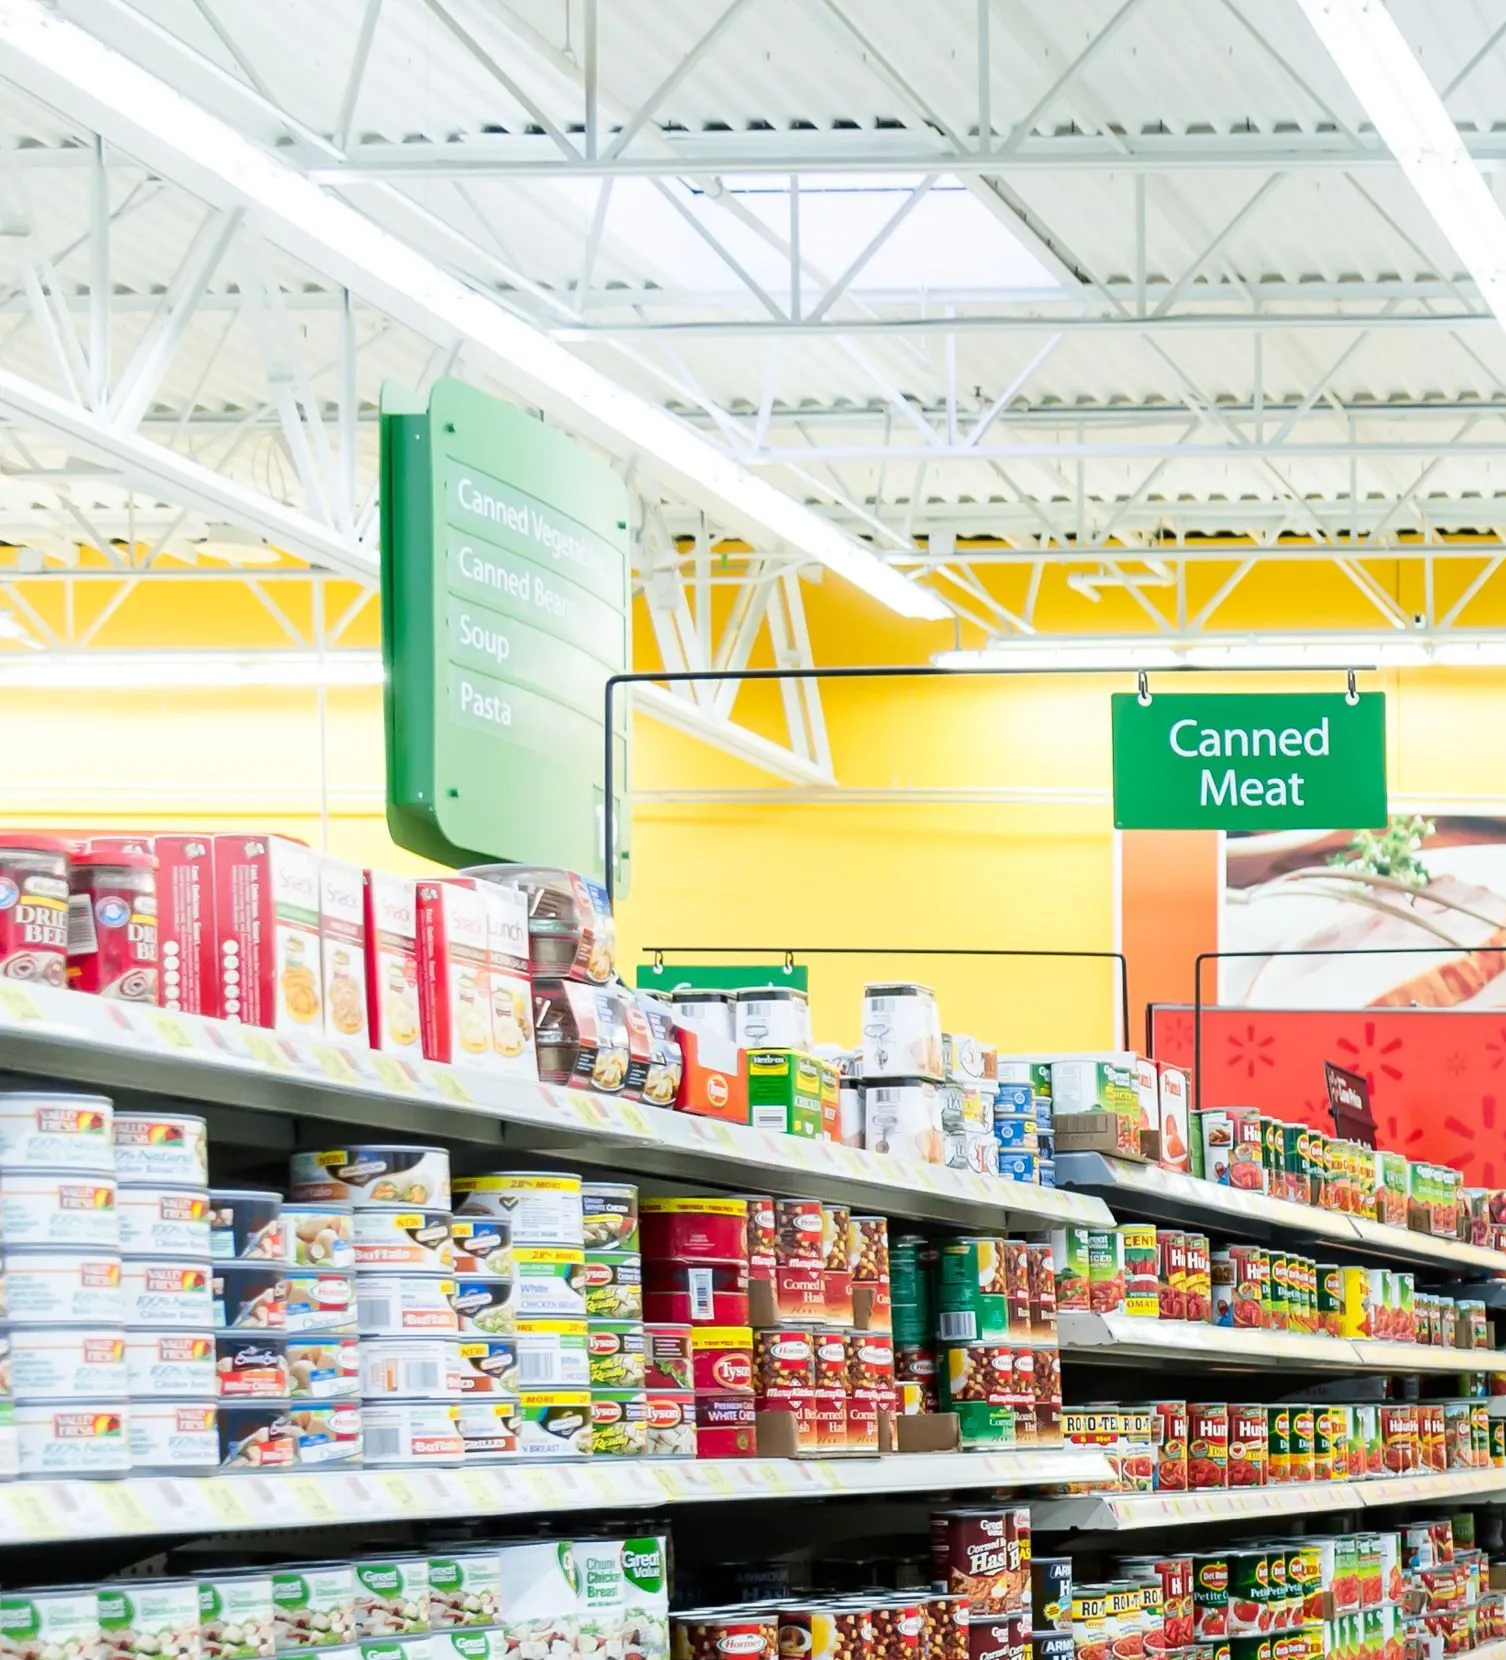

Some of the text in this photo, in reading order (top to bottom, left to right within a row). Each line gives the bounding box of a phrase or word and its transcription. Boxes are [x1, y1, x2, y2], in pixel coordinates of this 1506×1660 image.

[457, 478, 604, 570] Canned Vegetab
[457, 546, 573, 616] Canned Bean
[459, 613, 511, 664] Soup
[460, 680, 512, 726] Pasta
[1169, 717, 1330, 758] Canned
[1199, 769, 1305, 807] Meat
[646, 1406, 680, 1422] Tyson
[622, 1550, 661, 1568] Great
[719, 1636, 765, 1653] Hormel
